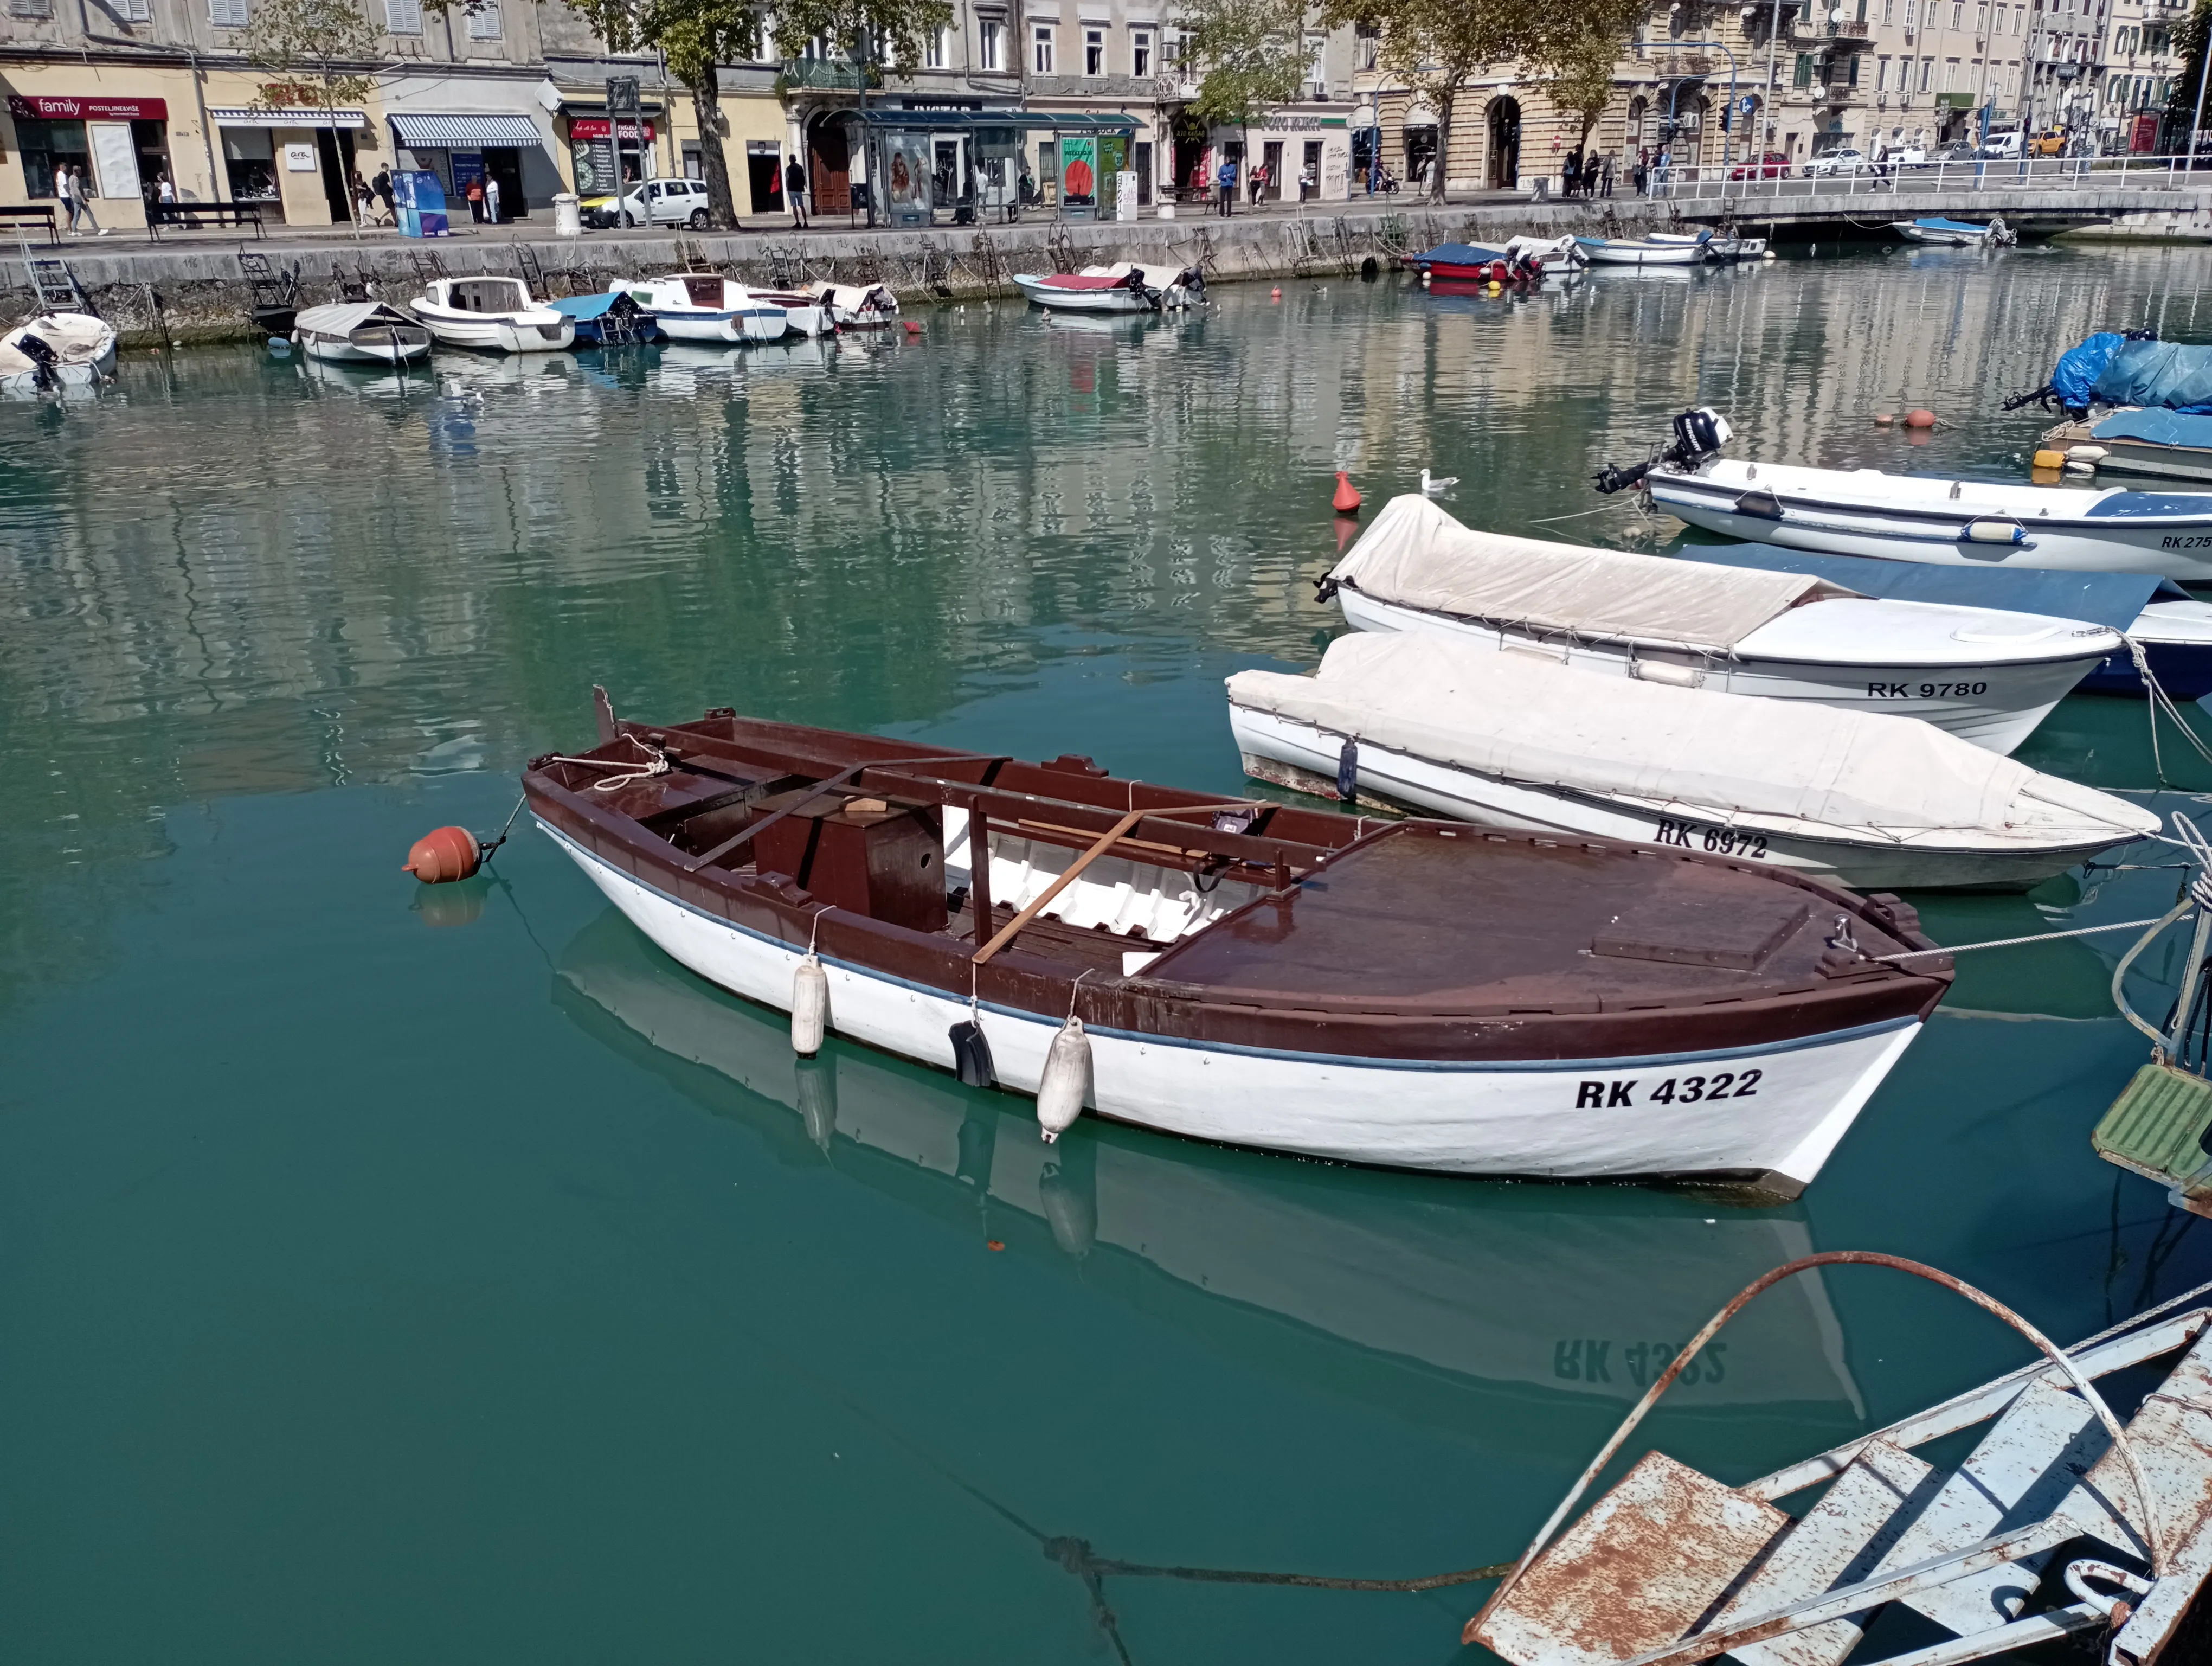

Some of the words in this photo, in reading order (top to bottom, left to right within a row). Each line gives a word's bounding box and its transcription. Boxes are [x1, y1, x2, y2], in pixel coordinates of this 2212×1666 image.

[38, 98, 80, 115] family
[438, 151, 451, 194] TORPEDO
[183, 258, 198, 268] 116
[1684, 418, 1702, 452] MERCURY
[2162, 536, 2183, 548] RK
[2184, 537, 2212, 548] 275
[1868, 682, 1910, 697] RK
[1920, 682, 1988, 698] 9780
[1653, 818, 1698, 848] RK
[1703, 828, 1768, 859] 6972
[1575, 1079, 1638, 1109] RK
[1649, 1068, 1763, 1105] 4322
